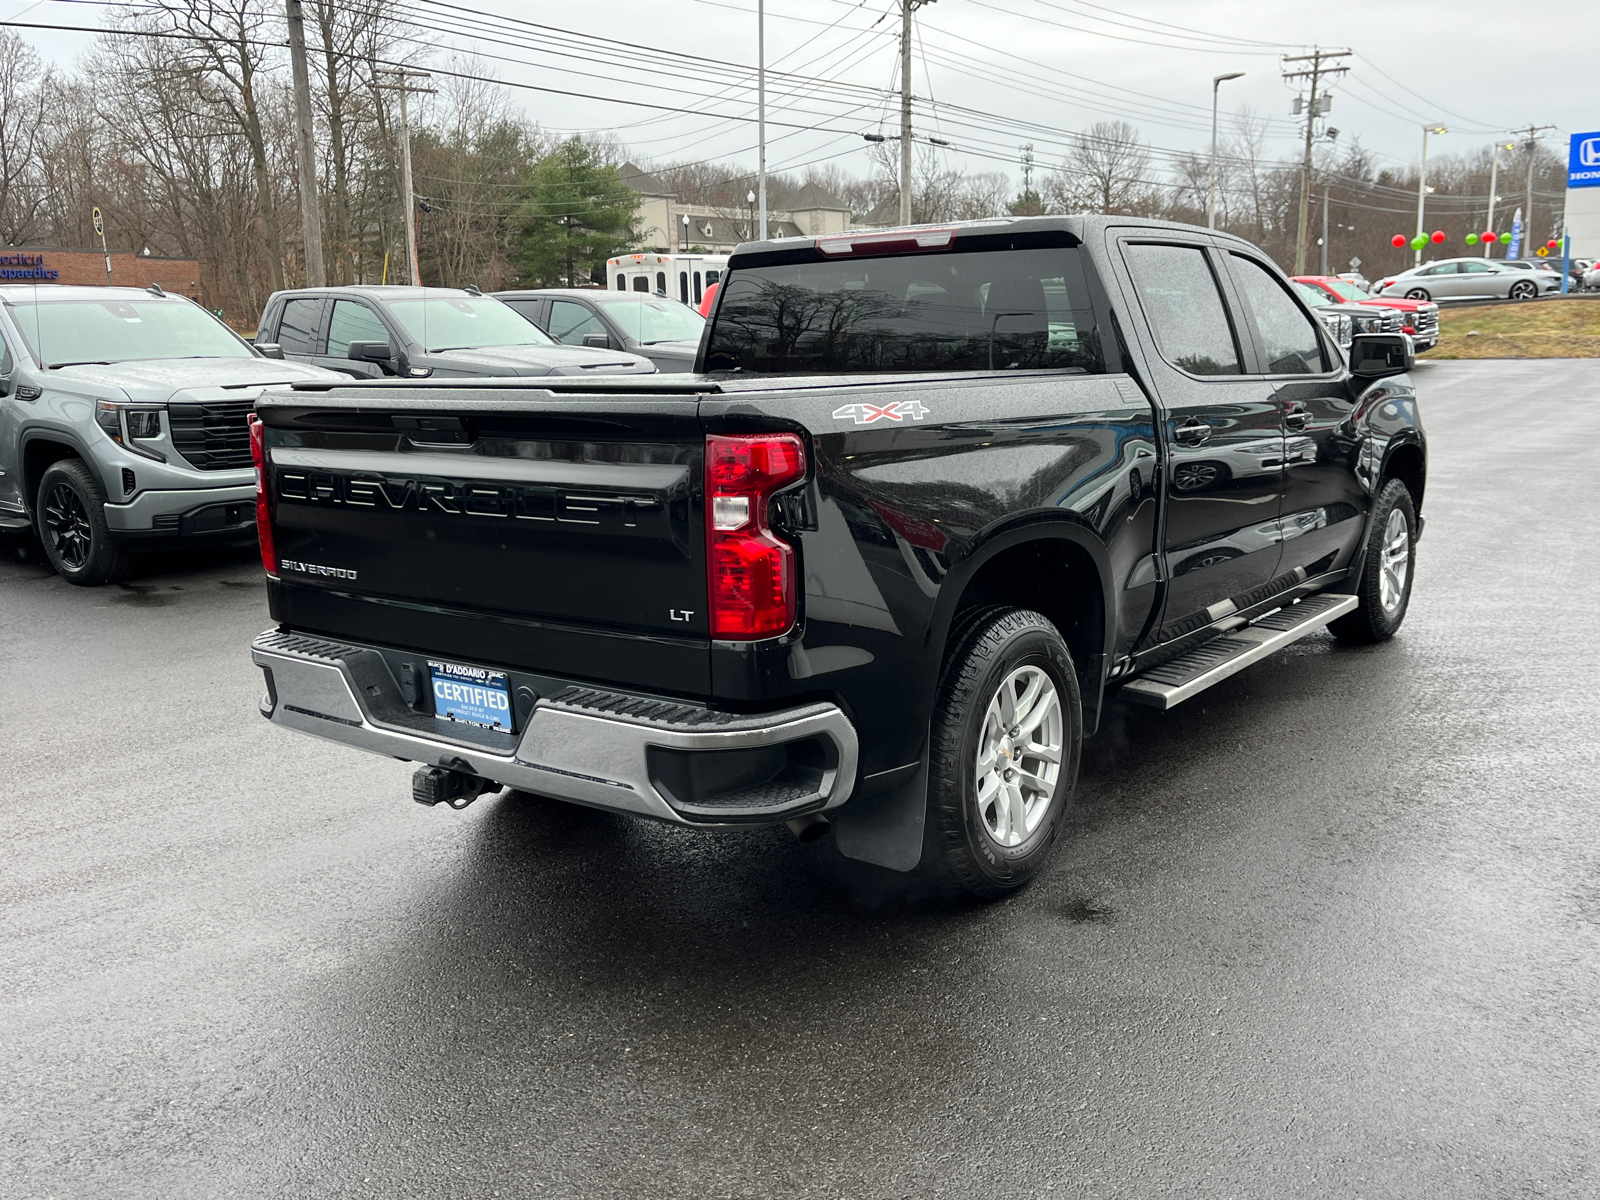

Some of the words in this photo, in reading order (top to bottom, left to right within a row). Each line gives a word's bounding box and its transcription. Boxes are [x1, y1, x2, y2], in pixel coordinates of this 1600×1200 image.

[0, 253, 43, 265] ecticut
[0, 267, 59, 280] opaedics
[832, 400, 930, 424] 4X4
[280, 471, 656, 527] CHEVROLET
[281, 559, 358, 580] SILVERADO
[670, 609, 694, 621] LT
[446, 664, 485, 679] D'ADDARIO
[434, 681, 509, 711] CERTIFIED
[447, 706, 471, 716] CHEVROLET
[472, 711, 485, 719] BUICK
[461, 704, 478, 712] BACKED
